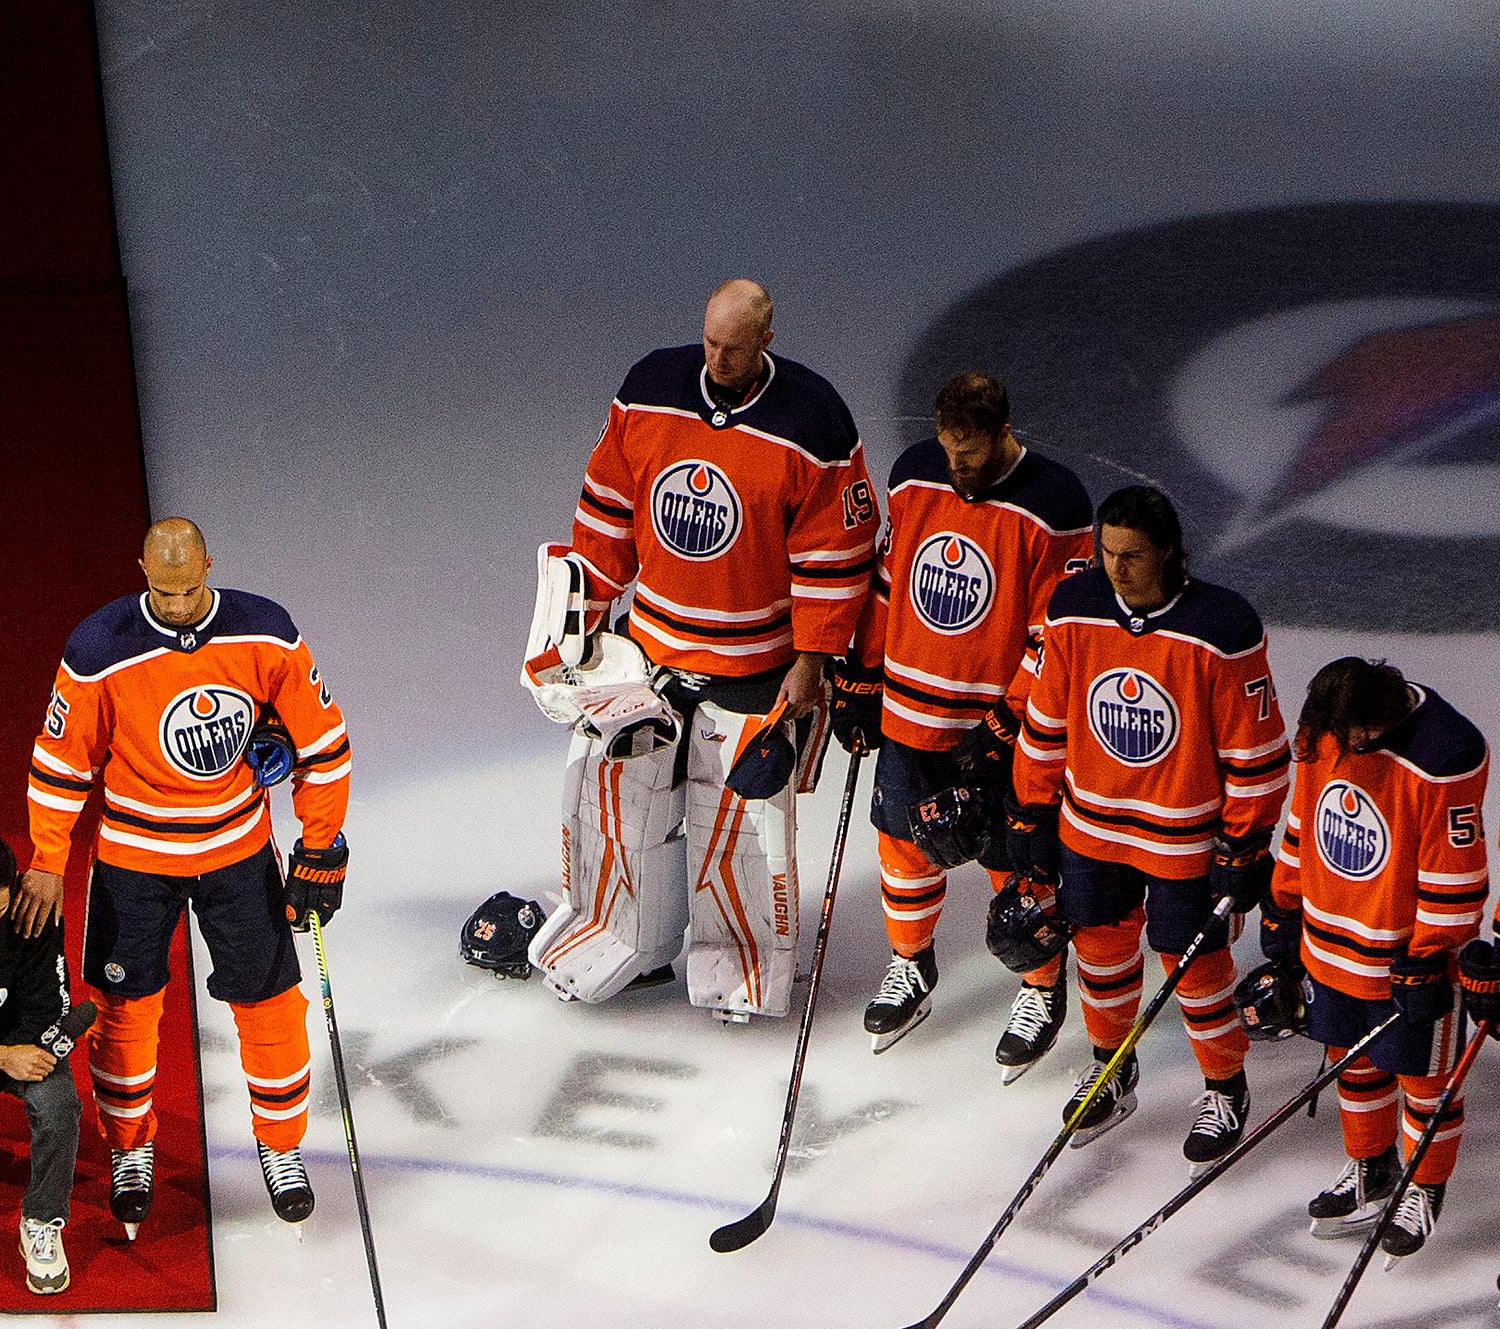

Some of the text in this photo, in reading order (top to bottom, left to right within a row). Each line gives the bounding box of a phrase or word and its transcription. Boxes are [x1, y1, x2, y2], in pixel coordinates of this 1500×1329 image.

[660, 490, 728, 552] OILERS
[841, 479, 875, 531] 19
[919, 563, 983, 627] OILERS
[46, 683, 71, 740] 5
[173, 709, 247, 772] OILERS
[1096, 699, 1177, 763] OILERS
[1321, 809, 1381, 875] OILERS
[1448, 805, 1486, 848] 5
[772, 870, 790, 937] VAUGHN
